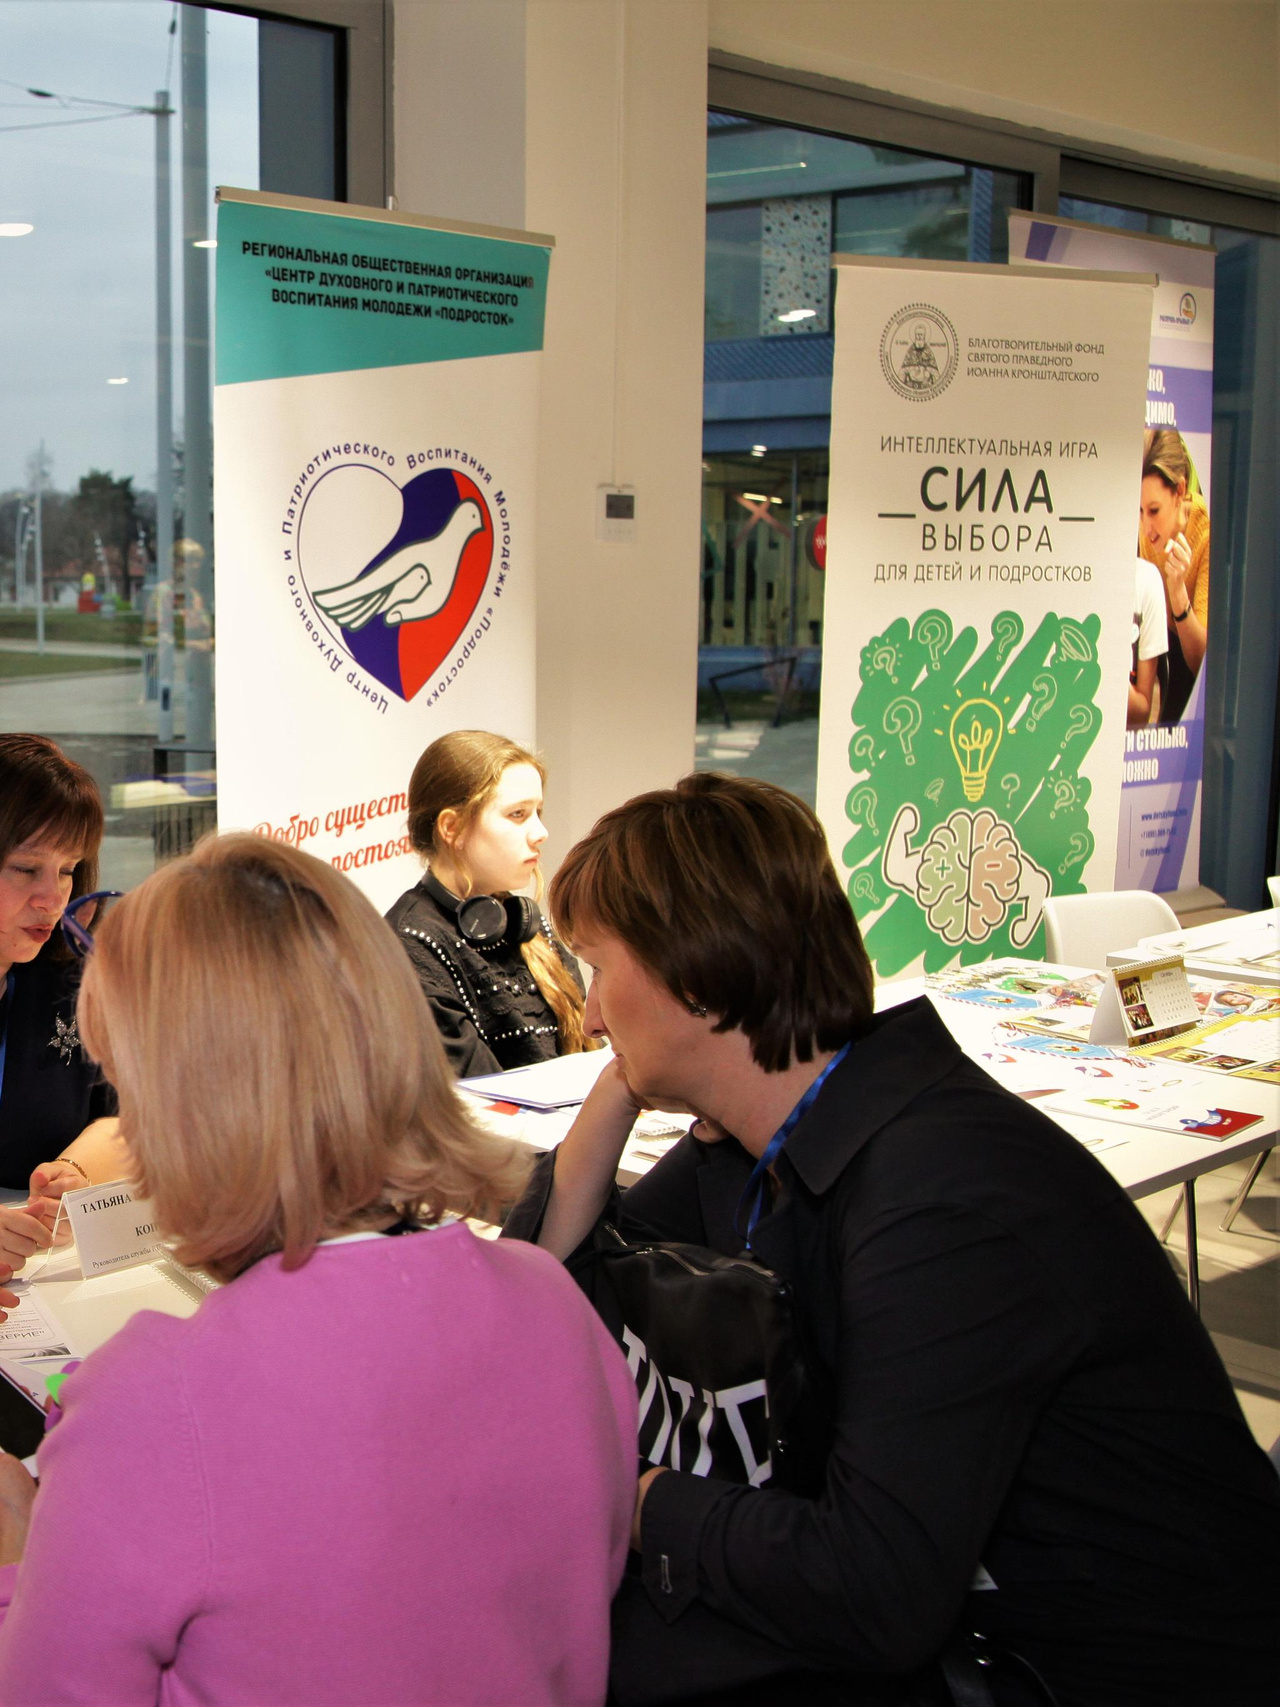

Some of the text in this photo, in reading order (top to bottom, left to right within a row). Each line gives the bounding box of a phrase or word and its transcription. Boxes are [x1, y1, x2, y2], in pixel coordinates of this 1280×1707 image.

[242, 240, 534, 290] РЕГИОНАЛЬНАЯ ОБЩЕСТВЕННАЯ ОРГАНИЗАЦИЯ
[265, 266, 519, 307] «ЦЕНТР ДУХОВНОГО И ПАТРИОТИЧЕСКОГО
[272, 289, 514, 326] ВОСПИТАНИЯ МОЛОДЕЖИ «ПОДРОСТОК»
[967, 352, 1073, 367] СВЯТОГО ПРАВЕДНОГО
[968, 337, 1104, 355] БЛАГОТВОРИТЕЛЬНЫЙ ФОНД
[967, 367, 1099, 382] ИОАННА КРОНШТАДТСКОГО
[1147, 368, 1166, 395] КО,
[880, 435, 1098, 459] ИНТЕЛЛЕКТУАЛЬНАЯ ИГРА
[920, 466, 1053, 514] СИЛА
[922, 523, 1053, 553] ВЫБОРА
[282, 442, 511, 714] Центр Духовного и Патриотического Воспитания Молодёжи «Подросток»
[874, 561, 1092, 584] ДЛЯ ДЕТЕЙ И ПОДРОСТКОВ
[1136, 726, 1188, 753] СТОЛЬКО,
[325, 792, 410, 838] сущест
[332, 835, 413, 872] постоя
[81, 1193, 132, 1214] ТАТЬЯНА
[92, 1253, 130, 1269] Руководитель
[130, 1246, 151, 1260] службы
